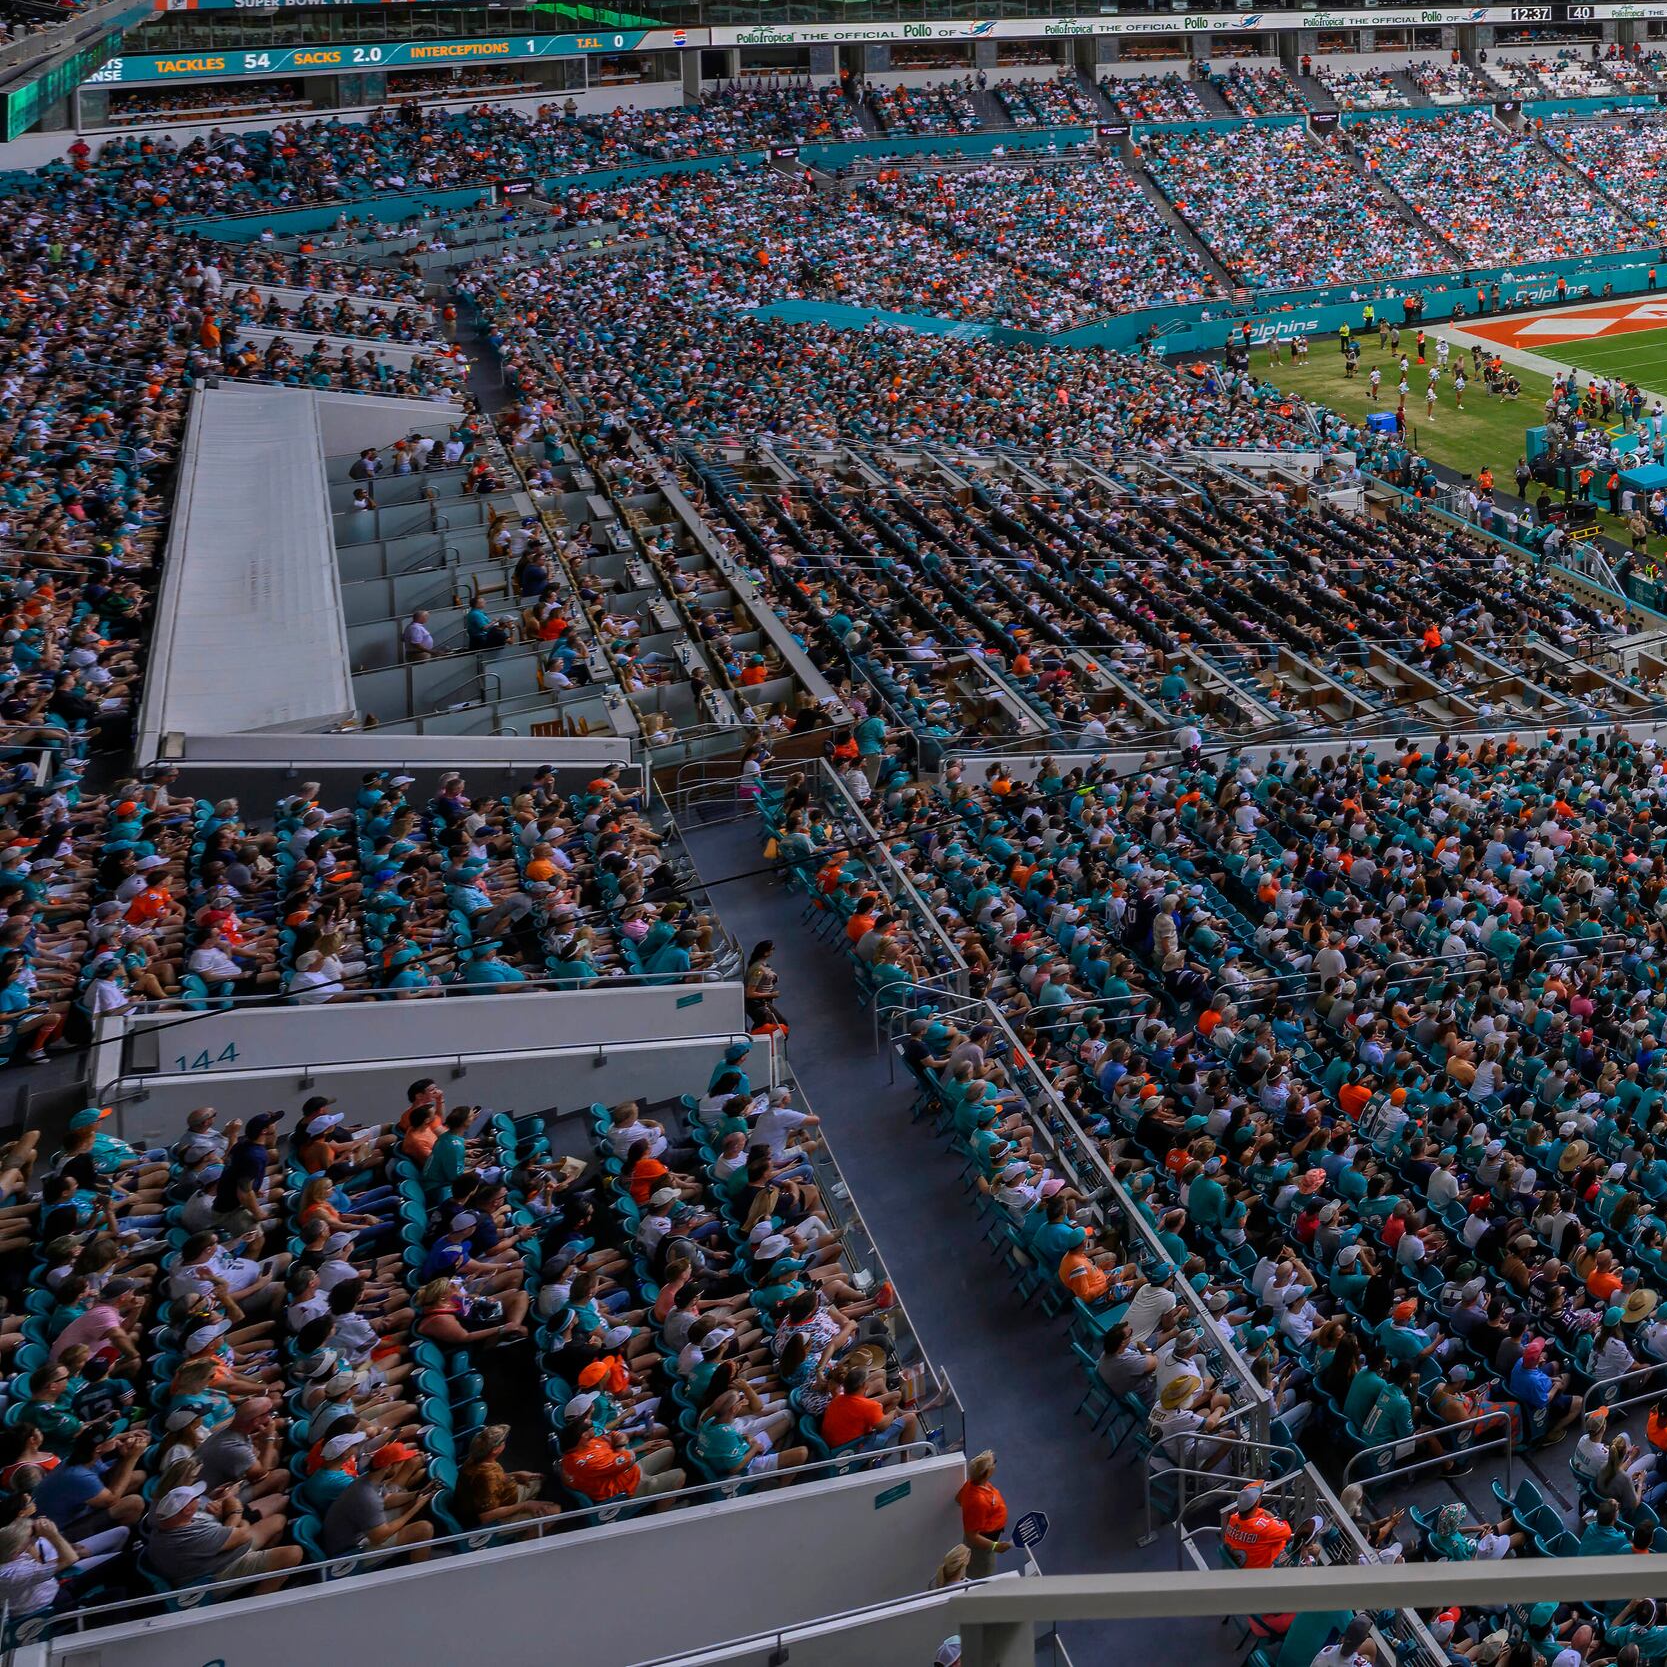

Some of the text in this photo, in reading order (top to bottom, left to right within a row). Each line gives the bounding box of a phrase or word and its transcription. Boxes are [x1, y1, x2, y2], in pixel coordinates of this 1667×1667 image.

[1511, 6, 1591, 21] 12:37 40
[614, 34, 624, 48] 0
[801, 32, 830, 41] THE
[833, 29, 899, 40] OFFICIAL
[903, 24, 932, 38] Pollo
[939, 29, 957, 37] OF
[293, 47, 383, 66] SACKS 2.0
[410, 38, 535, 59] INTERCEPTIONS 1
[154, 52, 271, 74] TACKLES 54
[175, 1042, 241, 1072] 144
